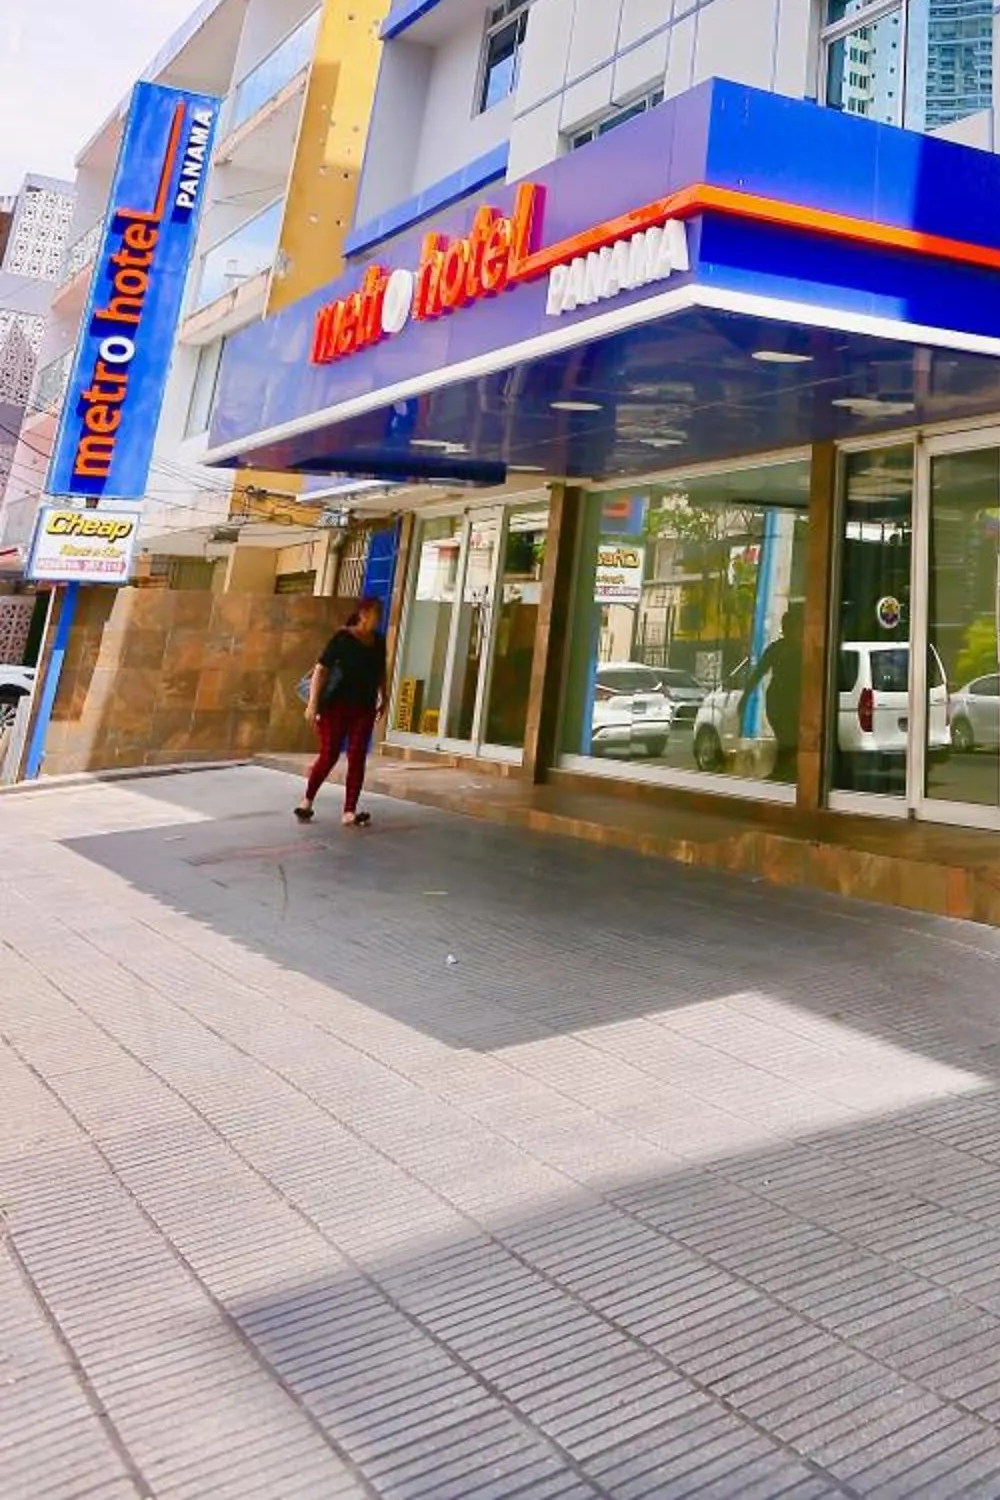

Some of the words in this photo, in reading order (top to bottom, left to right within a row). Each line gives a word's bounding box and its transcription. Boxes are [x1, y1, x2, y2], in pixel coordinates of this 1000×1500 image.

[175, 109, 214, 209] PANAMA
[95, 205, 161, 324] hotel
[411, 181, 540, 322] hotel
[546, 218, 689, 315] PANAMA
[73, 335, 135, 477] metro
[46, 511, 134, 543] Cheap
